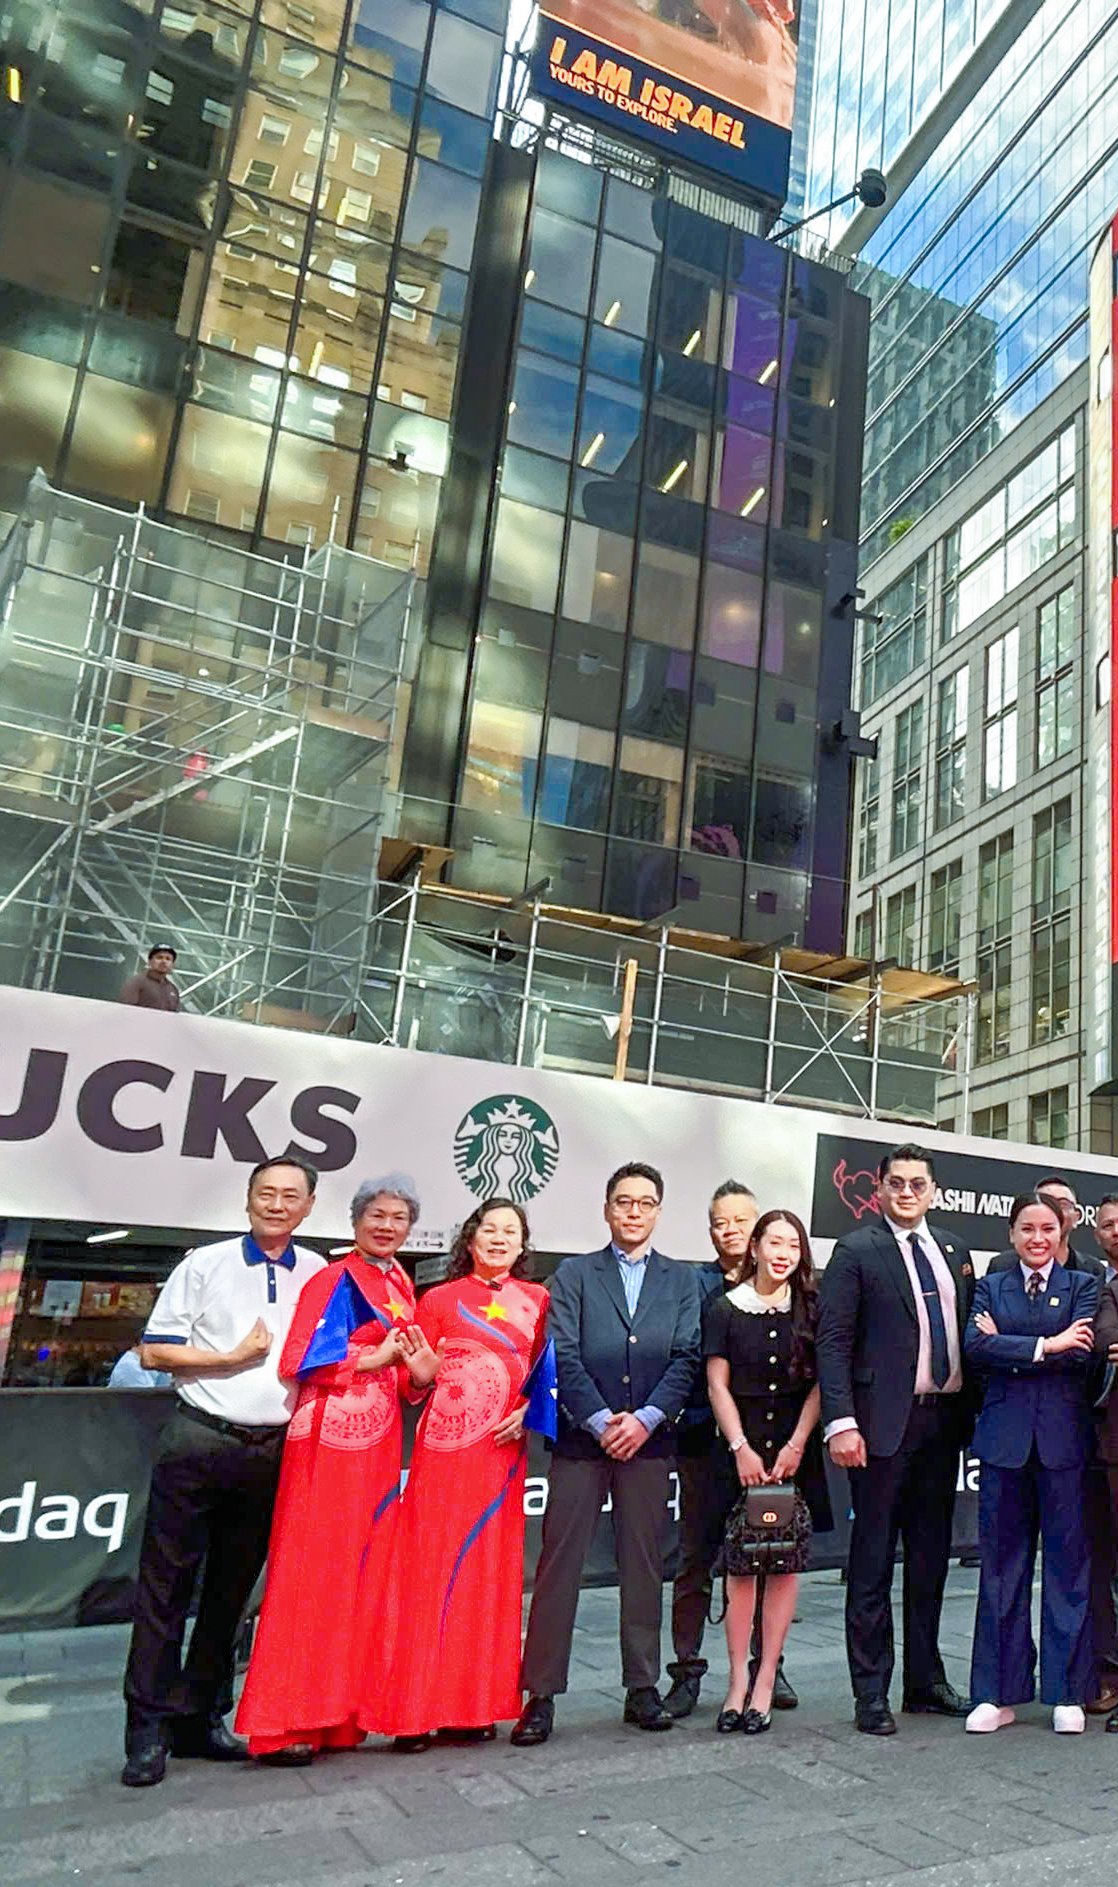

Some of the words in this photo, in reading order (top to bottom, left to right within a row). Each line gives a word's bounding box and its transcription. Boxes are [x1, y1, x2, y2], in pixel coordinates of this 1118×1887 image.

[550, 37, 567, 64] I
[571, 49, 632, 95] AM
[639, 78, 746, 149] ISRAEL
[550, 63, 595, 94] YOURS
[597, 83, 614, 105] TO
[616, 96, 679, 134] EXPLORE.
[928, 1187, 976, 1214] ASHII
